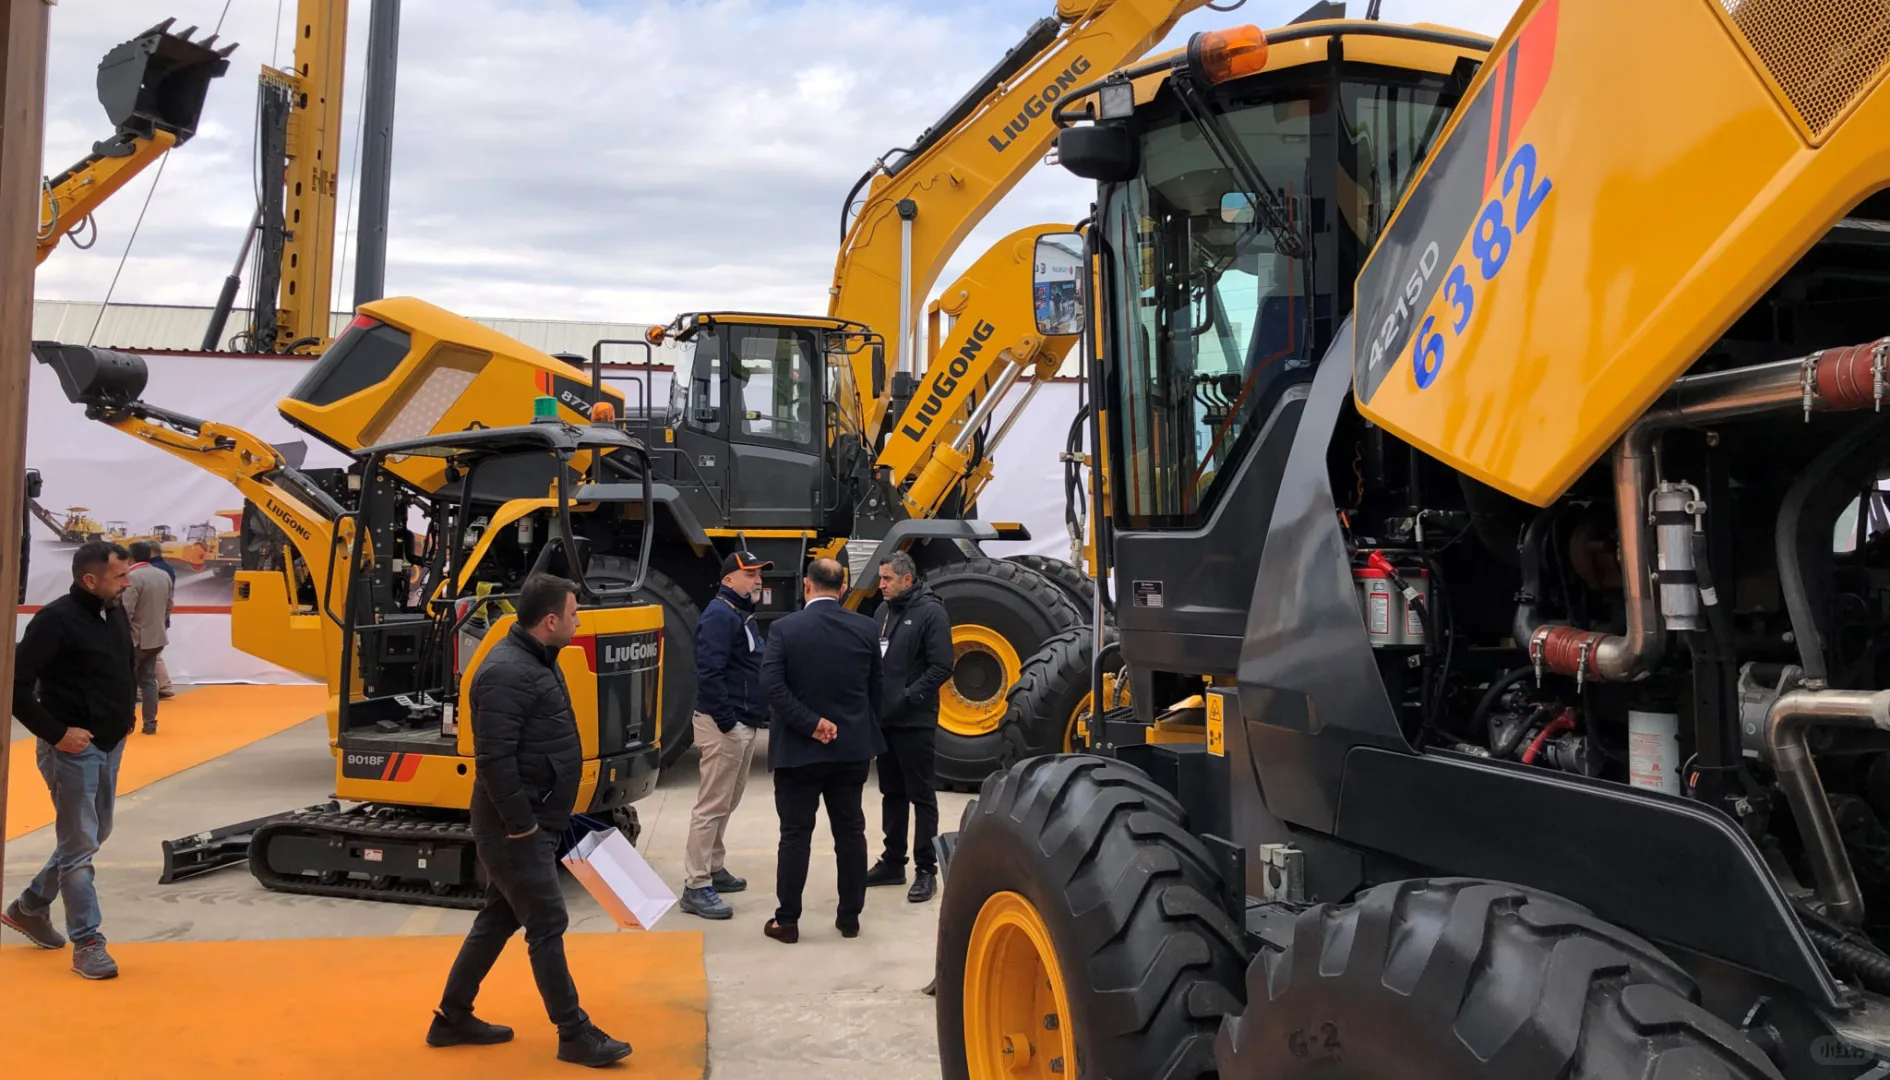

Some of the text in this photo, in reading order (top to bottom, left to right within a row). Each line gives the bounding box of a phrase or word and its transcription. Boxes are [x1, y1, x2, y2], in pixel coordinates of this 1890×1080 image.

[1369, 241, 1440, 372] 4215D
[1412, 143, 1553, 390] 6382
[347, 754, 385, 766] 9018F
